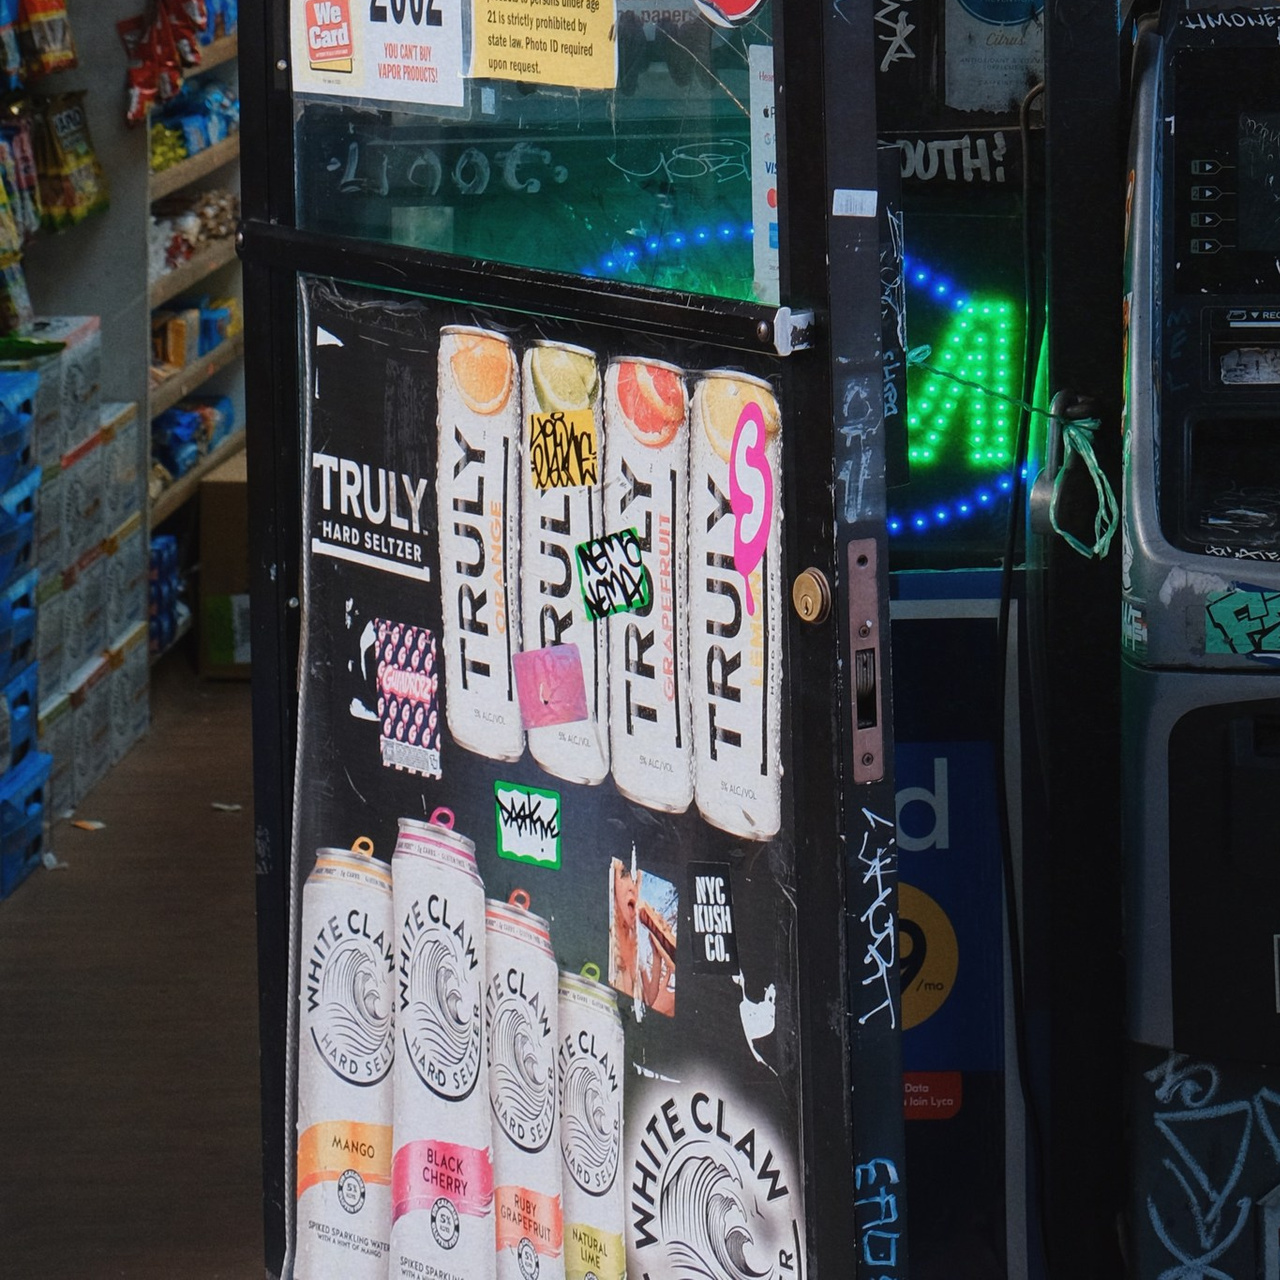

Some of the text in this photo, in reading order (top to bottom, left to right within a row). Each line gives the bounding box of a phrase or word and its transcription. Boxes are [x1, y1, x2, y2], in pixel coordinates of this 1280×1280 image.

[313, 0, 342, 26] We
[487, 10, 588, 36] 21 is strictly prohibited by
[308, 22, 350, 51] Card
[488, 34, 593, 58] state law. Photo ID required
[384, 42, 432, 62] YOU CAN'T BUY
[488, 58, 542, 75] upon request.
[378, 63, 438, 83] VAPOR PRODUCTS!
[312, 452, 428, 536] TRULY
[321, 519, 423, 563] HARD SELTZER
[453, 424, 491, 692] TRULY
[695, 875, 725, 905] NYC
[693, 903, 733, 934] KUSH
[399, 894, 479, 1012] WHITE CLAW
[704, 934, 731, 964] CO.
[307, 915, 343, 1013] WHITE
[930, 1096, 954, 1108] Lyca
[332, 1136, 376, 1159] MANGO
[427, 1148, 464, 1176] BLACK
[422, 1167, 468, 1197] CHERRY
[632, 1092, 789, 1249] WHITE CLAW
[514, 1193, 537, 1217] RUBY
[500, 1207, 551, 1242] GRAPEFRUIT
[572, 1228, 608, 1258] NATURAL
[580, 1247, 601, 1270] LIME
